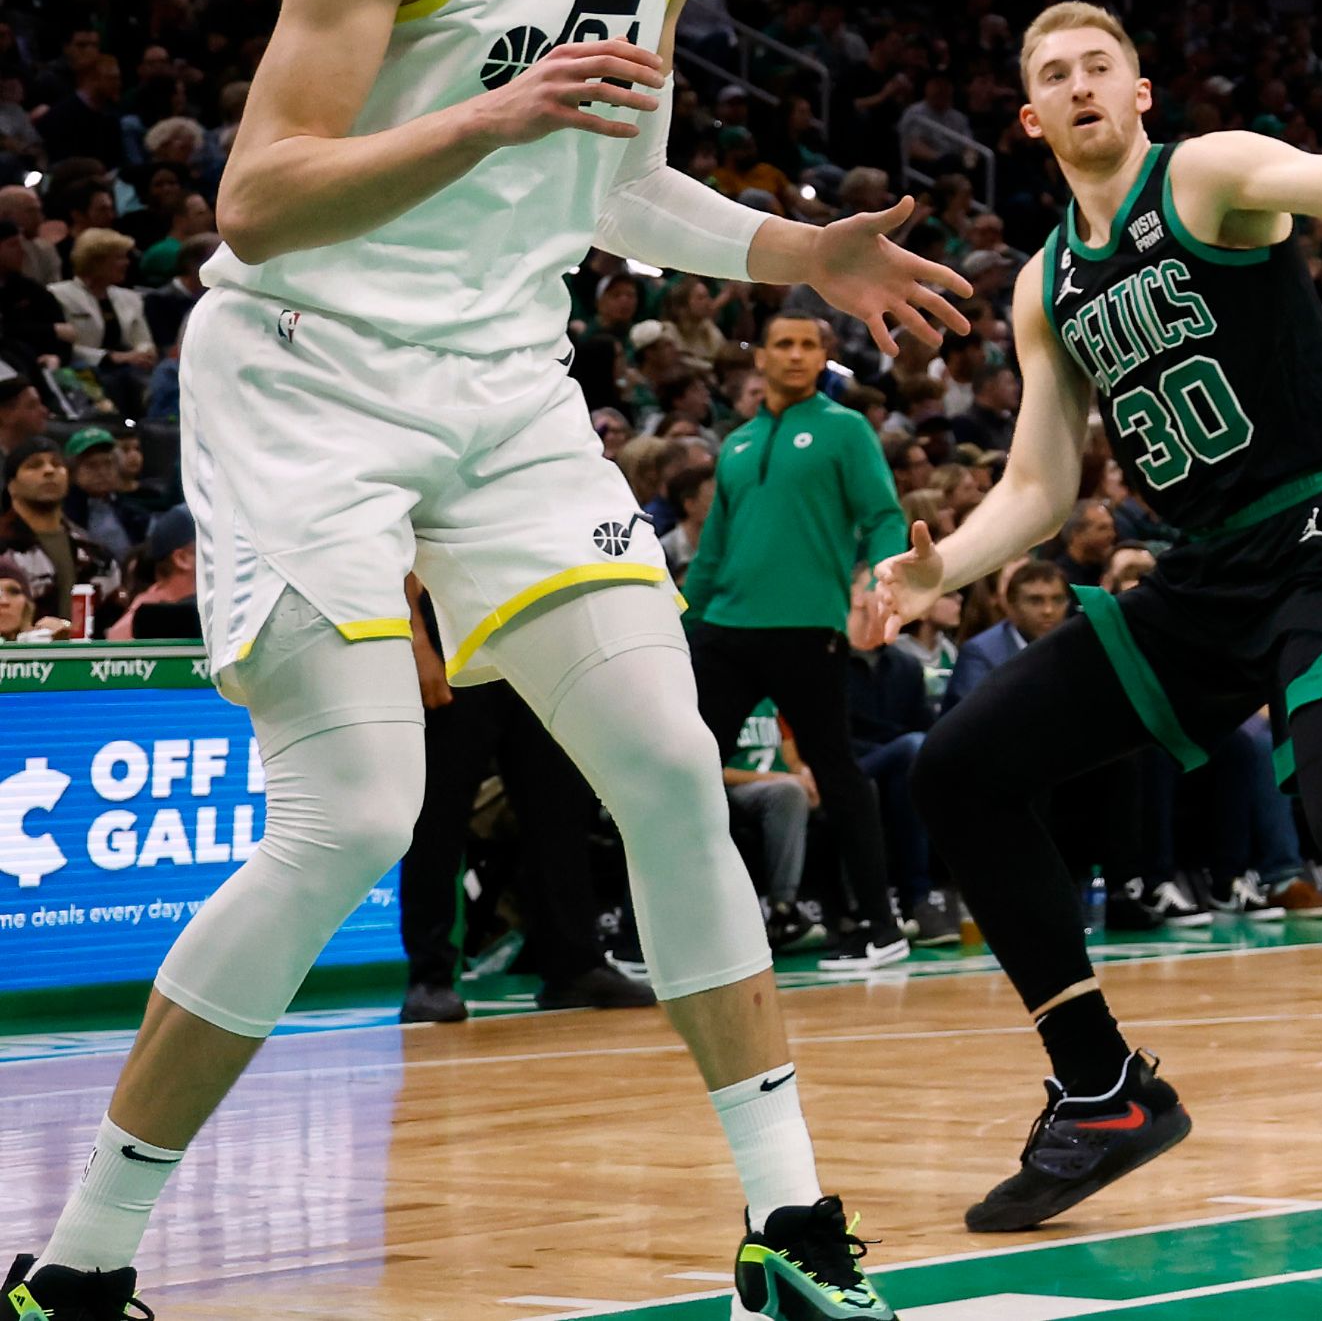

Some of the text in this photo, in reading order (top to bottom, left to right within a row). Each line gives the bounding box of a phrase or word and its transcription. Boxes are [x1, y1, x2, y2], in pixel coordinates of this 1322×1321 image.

[1127, 209, 1161, 241] VISTA
[1134, 224, 1165, 254] PRINT
[1060, 246, 1072, 271] 6
[1061, 257, 1218, 398] CELTICS
[1112, 354, 1254, 491] 30
[90, 659, 156, 682] xfinity
[90, 738, 230, 802] OFF
[31, 903, 86, 927] deals
[89, 904, 145, 925] every
[147, 897, 185, 920] day
